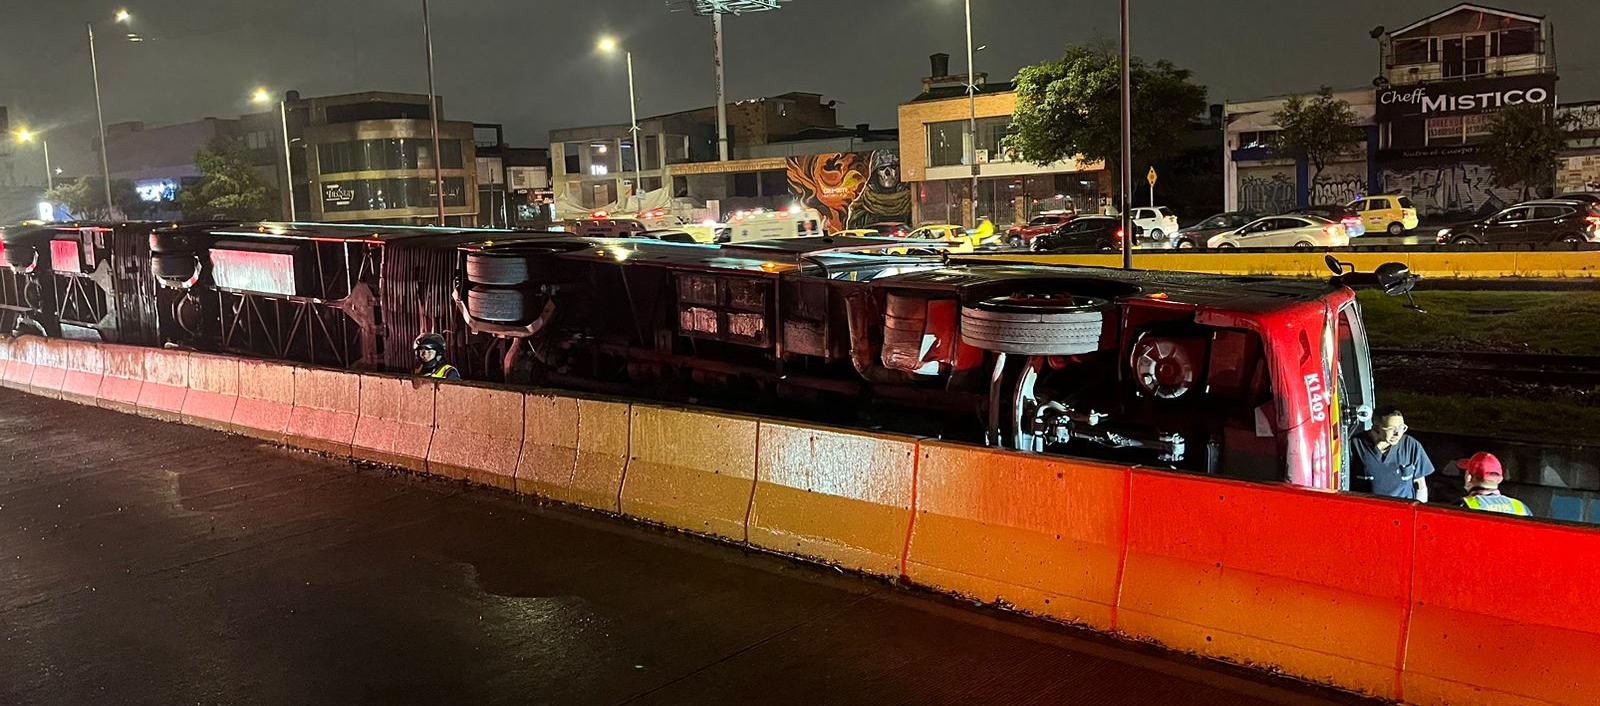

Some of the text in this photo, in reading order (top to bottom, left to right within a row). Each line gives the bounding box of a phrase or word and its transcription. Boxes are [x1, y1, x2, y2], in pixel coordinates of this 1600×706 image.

[1380, 87, 1426, 105] Cheff
[1421, 87, 1547, 114] MISTICO
[1307, 373, 1326, 423] K1409
